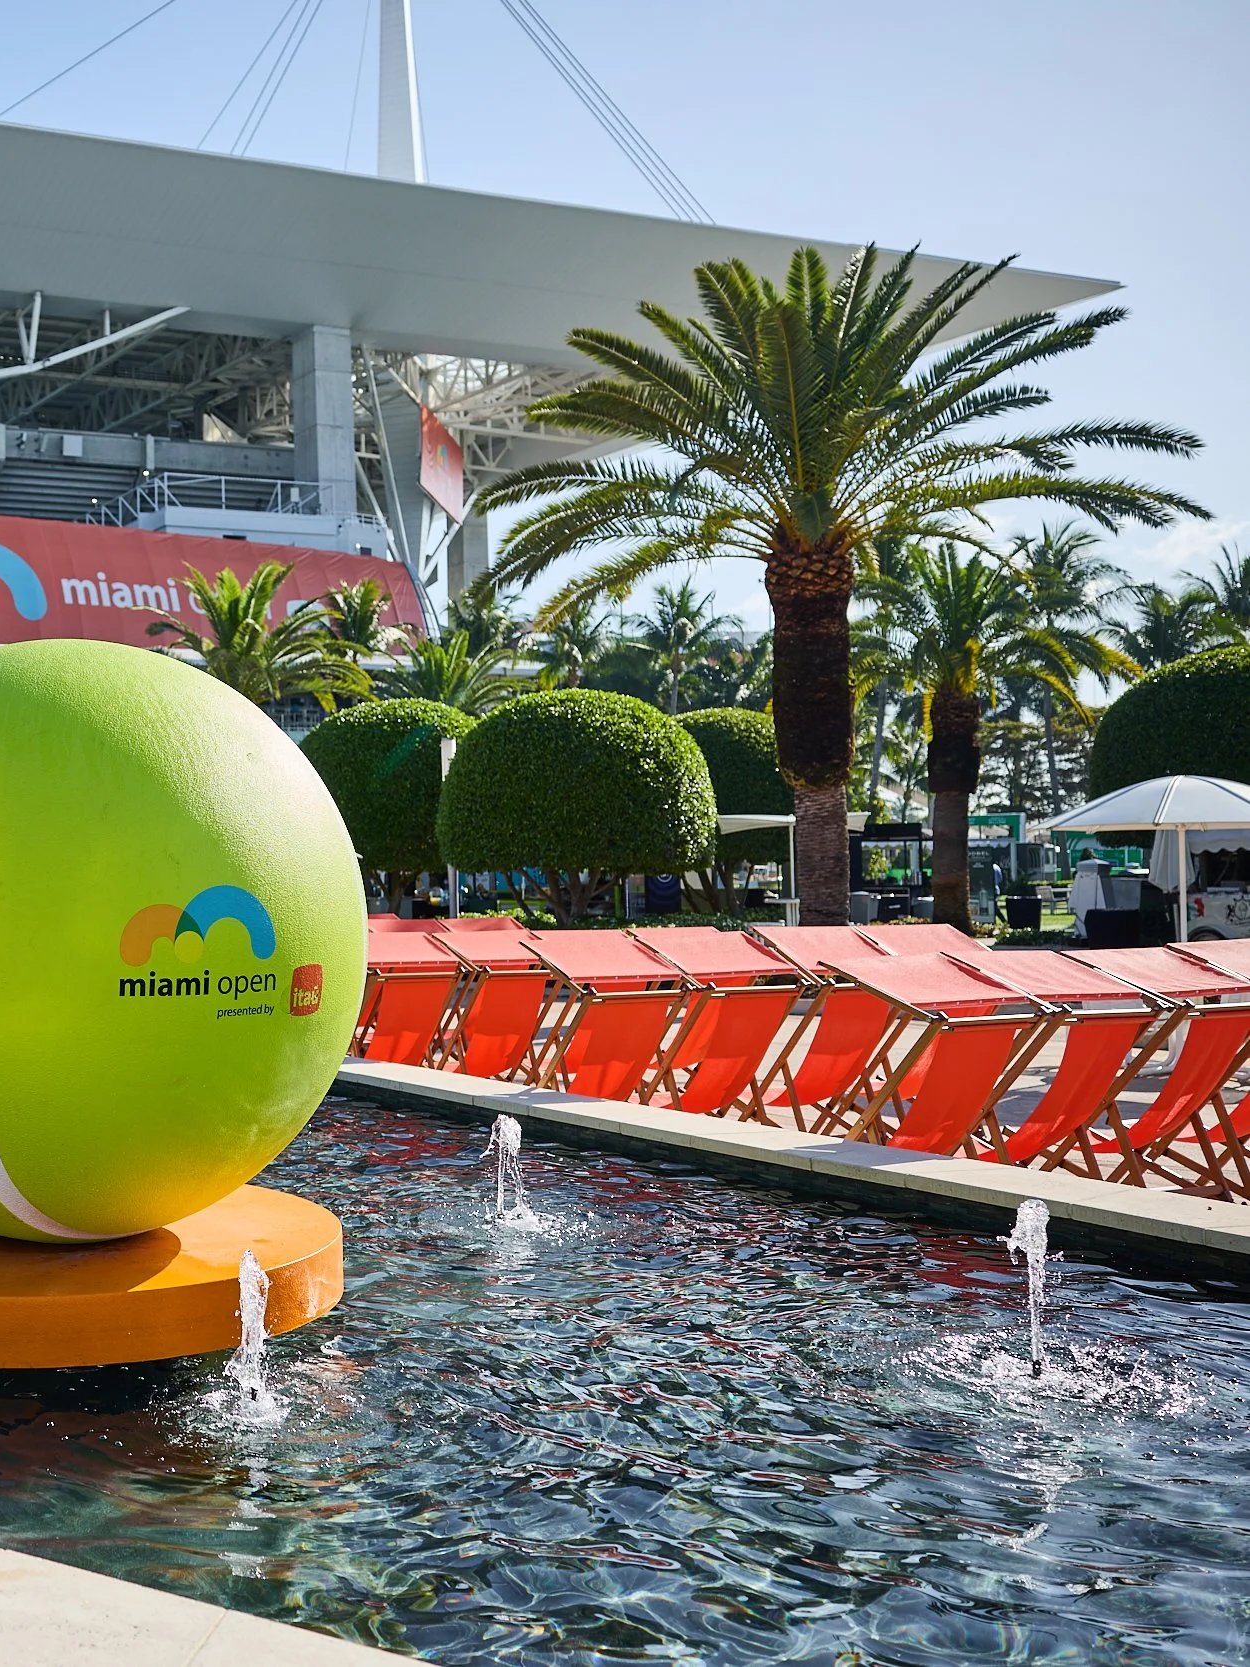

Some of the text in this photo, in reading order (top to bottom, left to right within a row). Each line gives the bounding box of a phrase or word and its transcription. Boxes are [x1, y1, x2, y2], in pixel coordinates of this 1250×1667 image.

[61, 571, 181, 612] miami
[119, 969, 276, 1000] miami open
[216, 1003, 275, 1019] presented by
